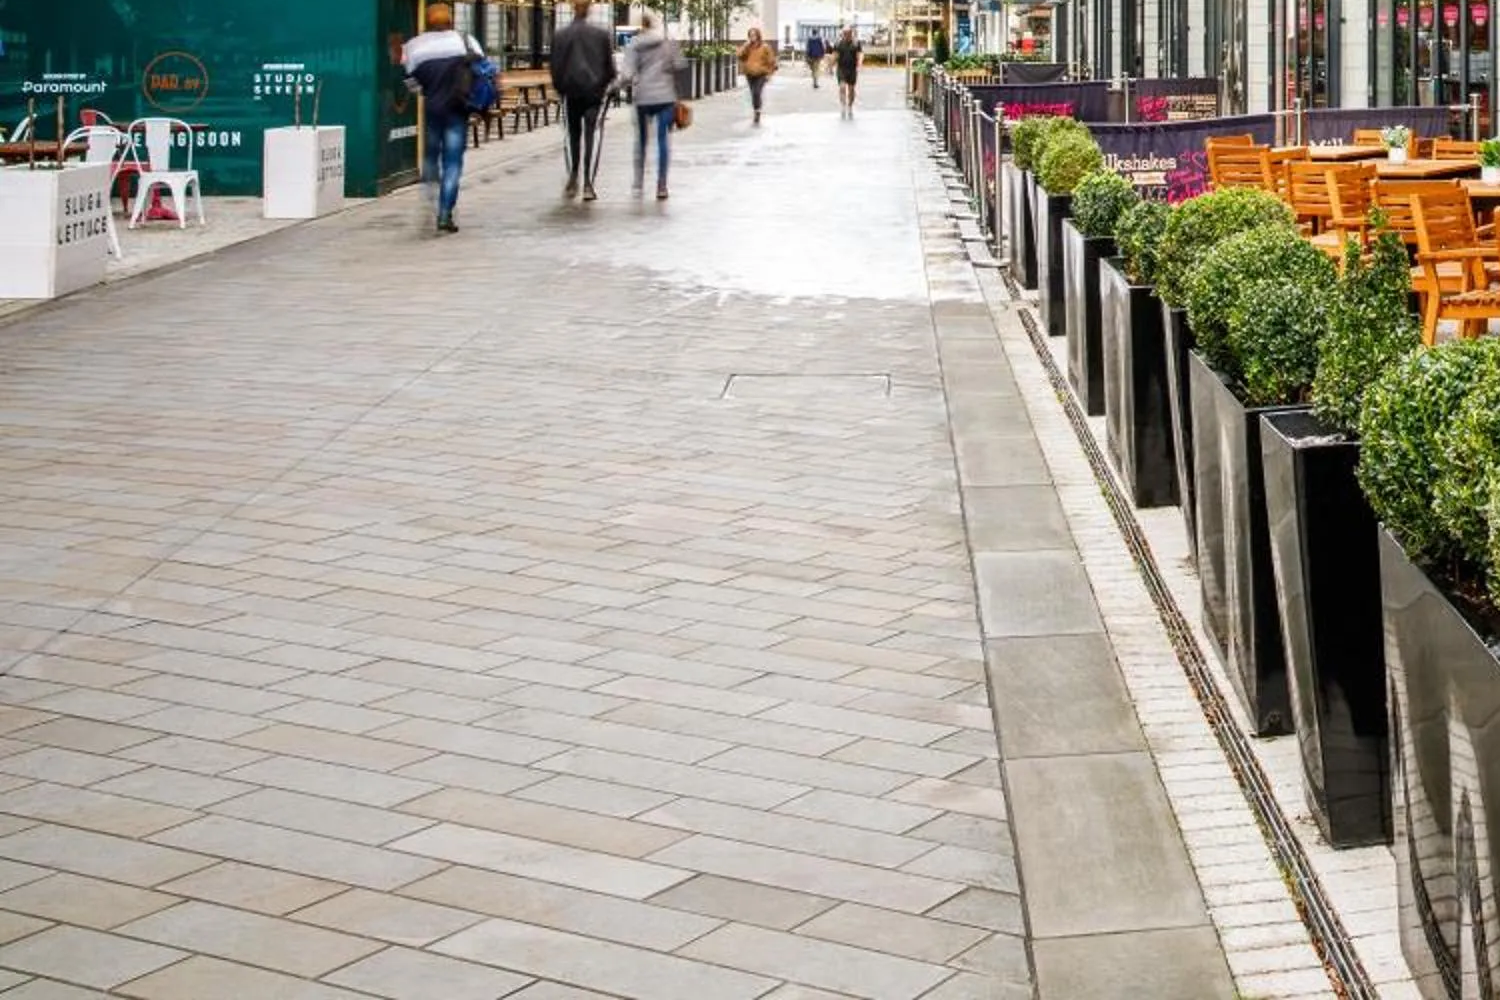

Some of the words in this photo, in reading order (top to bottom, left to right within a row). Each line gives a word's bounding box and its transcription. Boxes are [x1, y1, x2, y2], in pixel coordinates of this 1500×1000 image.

[254, 73, 315, 83] STUDIO
[22, 80, 108, 94] Paramount
[197, 131, 242, 147] SOON
[64, 193, 94, 216] SLUG
[57, 216, 107, 245] LETTUCE
